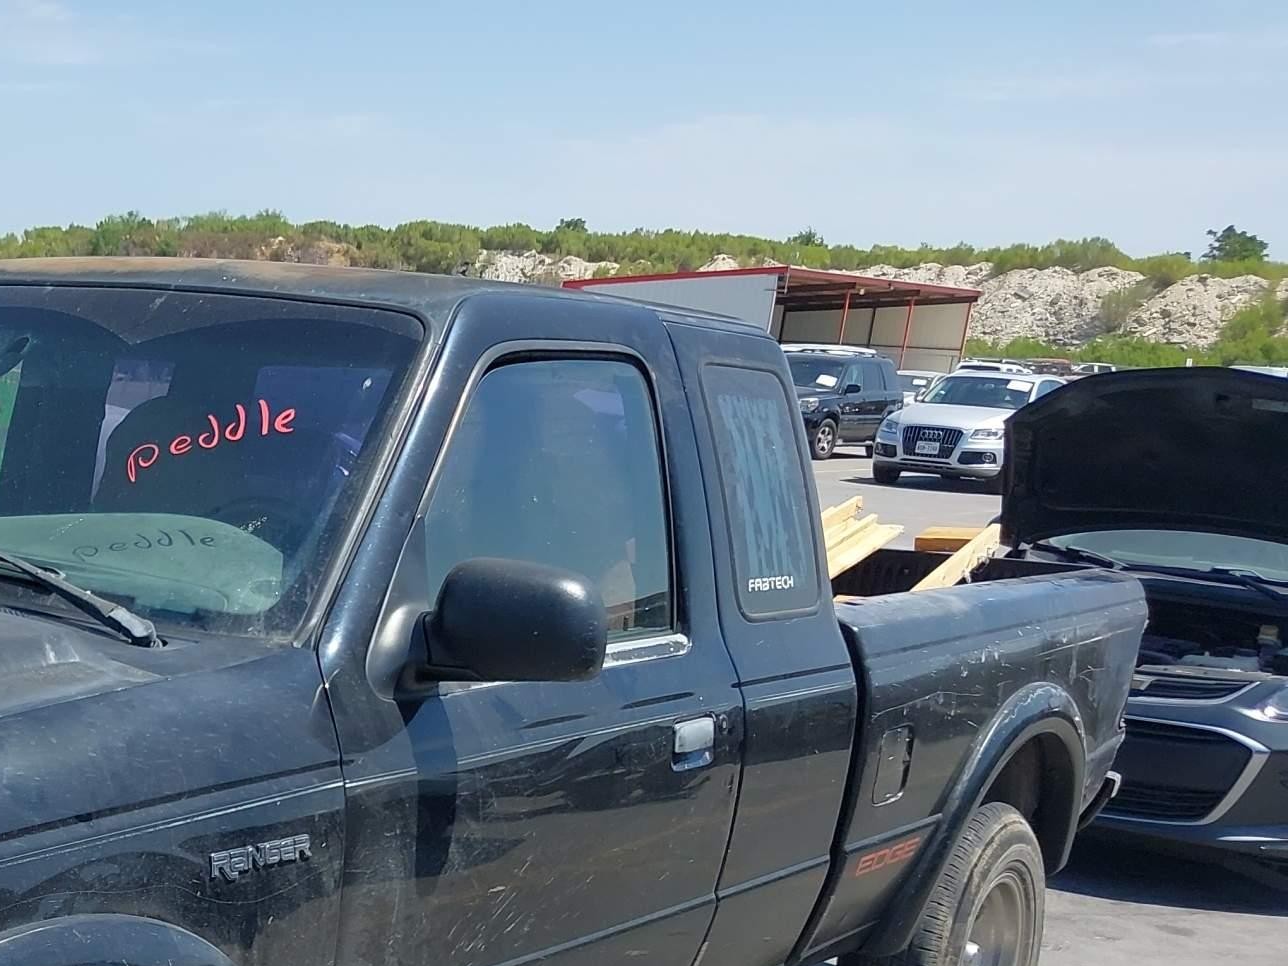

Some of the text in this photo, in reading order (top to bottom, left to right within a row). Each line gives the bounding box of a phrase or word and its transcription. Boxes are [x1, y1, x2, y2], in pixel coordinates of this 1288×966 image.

[127, 399, 296, 483] peddle
[748, 575, 794, 592] FABTECH
[210, 834, 312, 881] RANGER
[855, 837, 921, 877] EDGE
